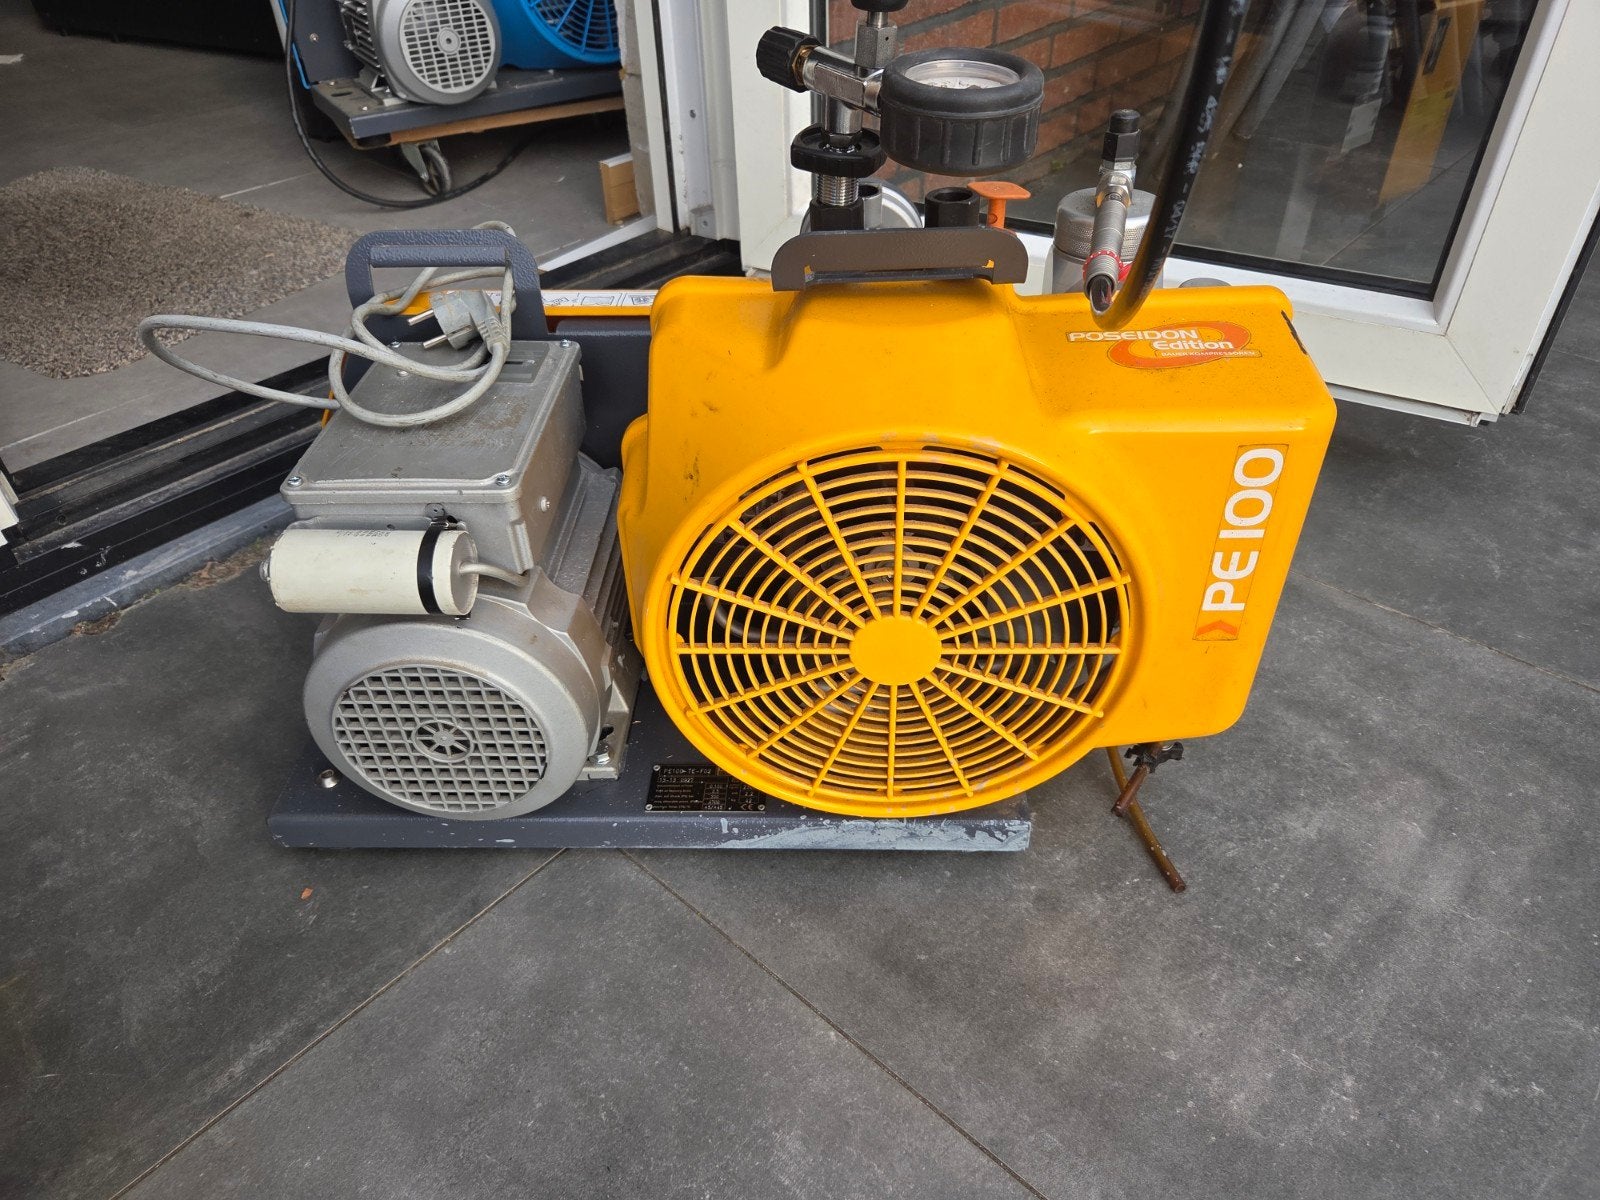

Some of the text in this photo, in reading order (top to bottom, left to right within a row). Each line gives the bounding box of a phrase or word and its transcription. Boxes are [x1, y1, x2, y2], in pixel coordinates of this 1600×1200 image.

[1068, 328, 1199, 342] POSEIDON
[1152, 339, 1234, 350] Edition
[1201, 448, 1284, 611] PE100
